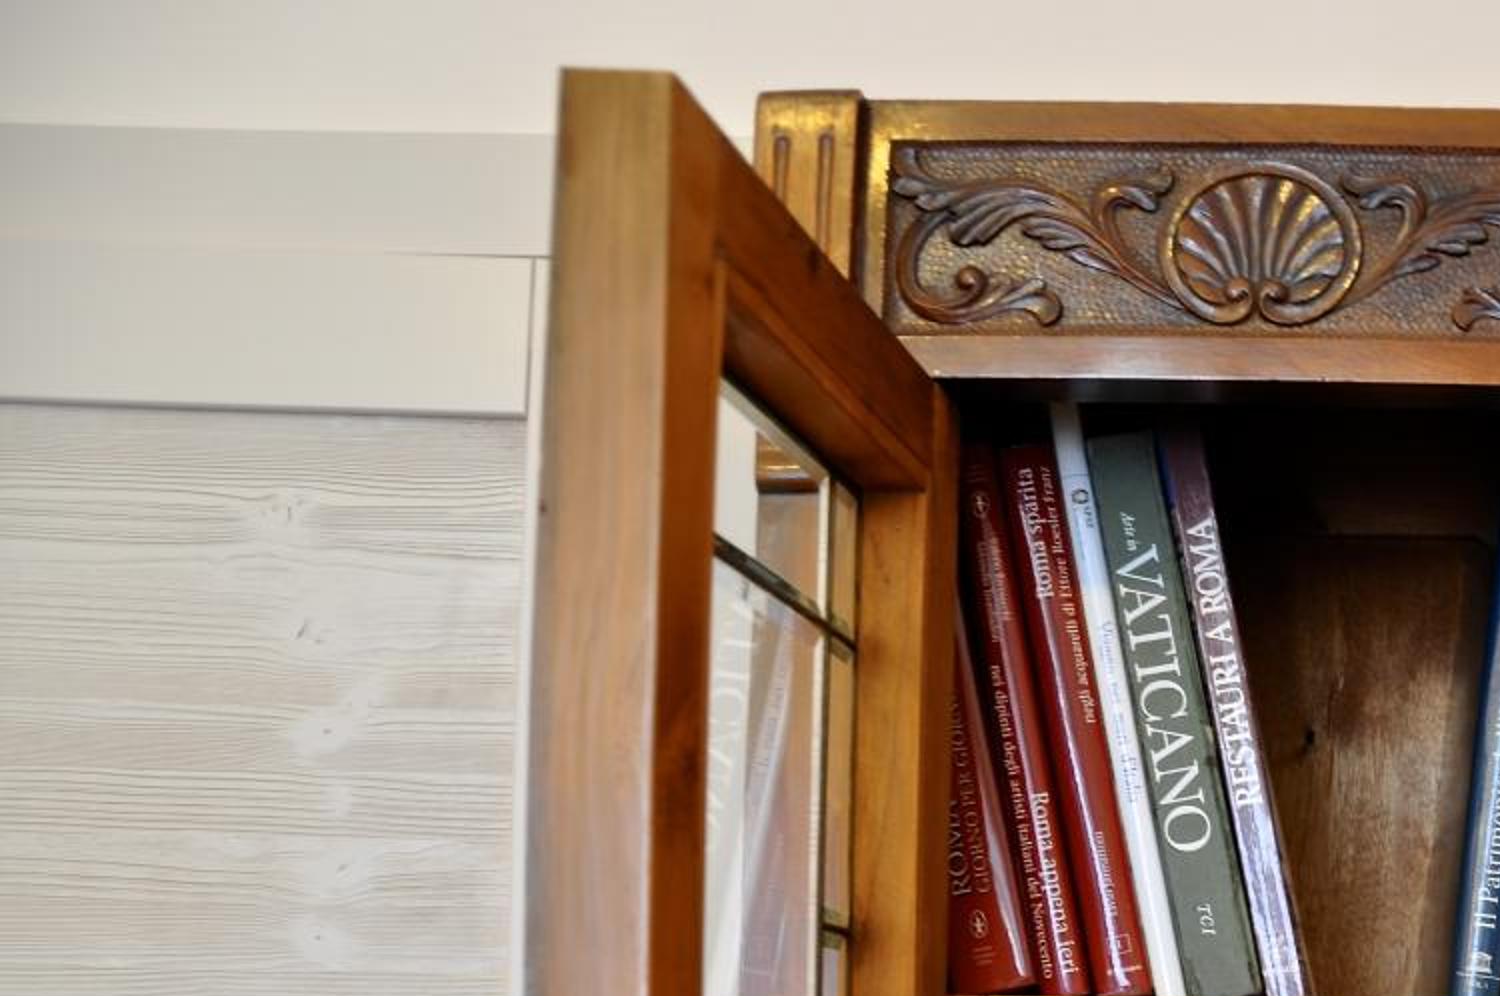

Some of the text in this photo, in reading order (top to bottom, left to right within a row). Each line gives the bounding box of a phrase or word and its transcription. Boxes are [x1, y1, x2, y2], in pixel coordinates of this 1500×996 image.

[1012, 466, 1055, 598] Roma sparita
[1124, 537, 1137, 551] in
[989, 664, 1003, 686] nei
[1184, 516, 1263, 807] RESTAURI A ROMA
[991, 690, 1013, 738] dipinti
[1114, 543, 1215, 855] VATICANO
[1000, 739, 1020, 776] degli
[958, 770, 976, 806] PER
[1009, 779, 1027, 820] artisti
[965, 810, 991, 893] GIORNO
[1017, 823, 1036, 873] italiani
[1026, 876, 1041, 900] del
[1029, 792, 1079, 975] Roma appena ieri
[1031, 902, 1055, 980] Novecento
[1195, 902, 1215, 937] TCI
[1473, 912, 1497, 928] Il
